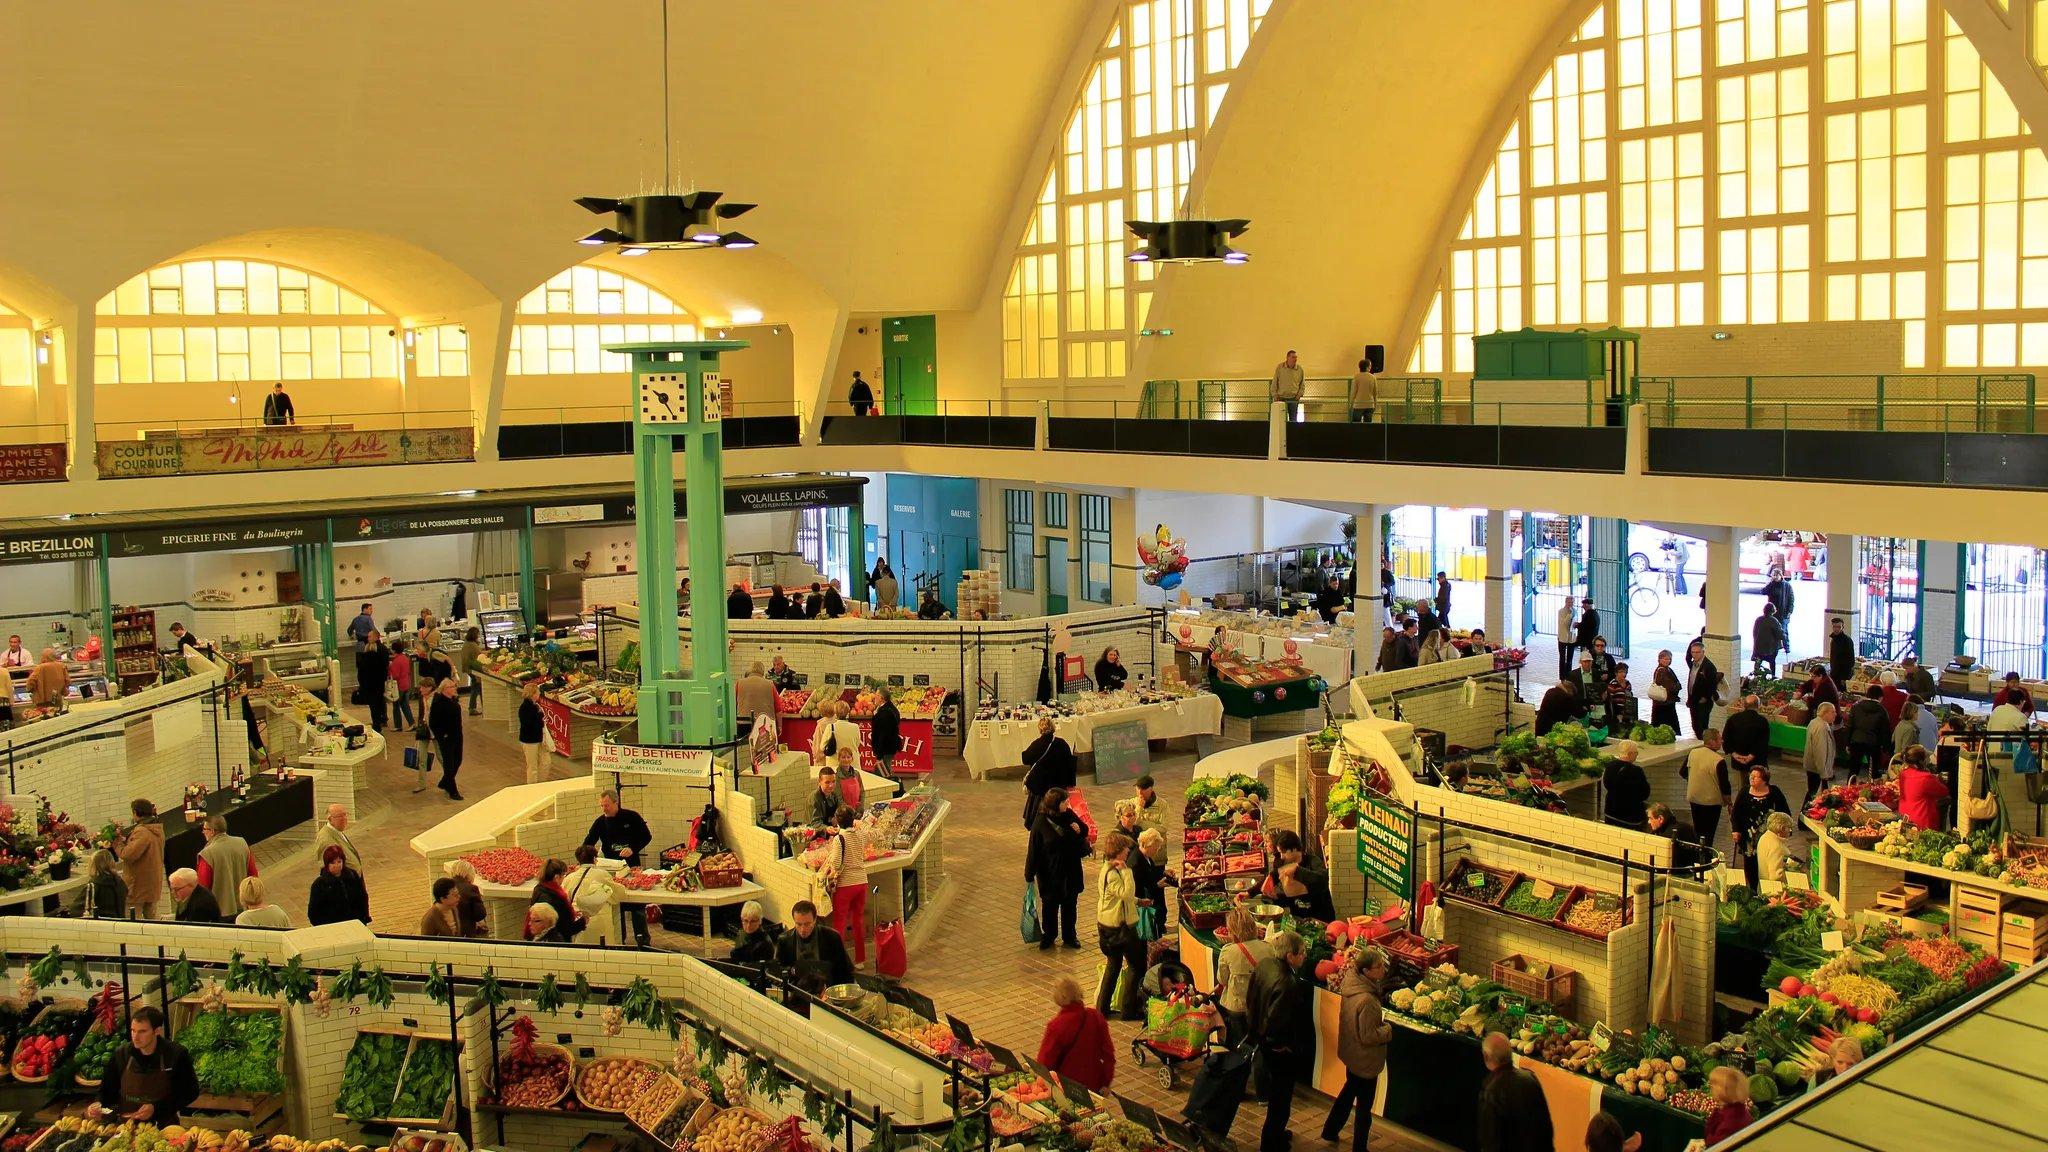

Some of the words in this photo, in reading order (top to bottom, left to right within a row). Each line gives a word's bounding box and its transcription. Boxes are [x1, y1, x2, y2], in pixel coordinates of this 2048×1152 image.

[114, 446, 181, 458] COUTUR
[0, 459, 47, 468] AMES
[741, 492, 793, 504] VOLAILLES,
[794, 490, 828, 501] LAPINS,
[950, 509, 972, 518] GALERIE
[428, 518, 470, 528] POISSONNERIE
[470, 517, 482, 525] DES
[483, 516, 504, 524] HALLES
[161, 534, 211, 545] EPICERIE
[212, 532, 238, 542] FINE
[243, 531, 255, 540] du
[257, 527, 304, 541] Boulingrin
[9, 537, 94, 554] BREZILLON
[623, 747, 639, 757] DE
[596, 755, 618, 763] FRAISES
[630, 758, 662, 766] ASPERGES
[1360, 817, 1408, 855] PRODUCTEUR
[1361, 832, 1406, 866] HORTICULTEUR
[1365, 845, 1401, 872] MARAICHER
[1373, 860, 1383, 872] LES
[349, 1006, 361, 1016] 72
